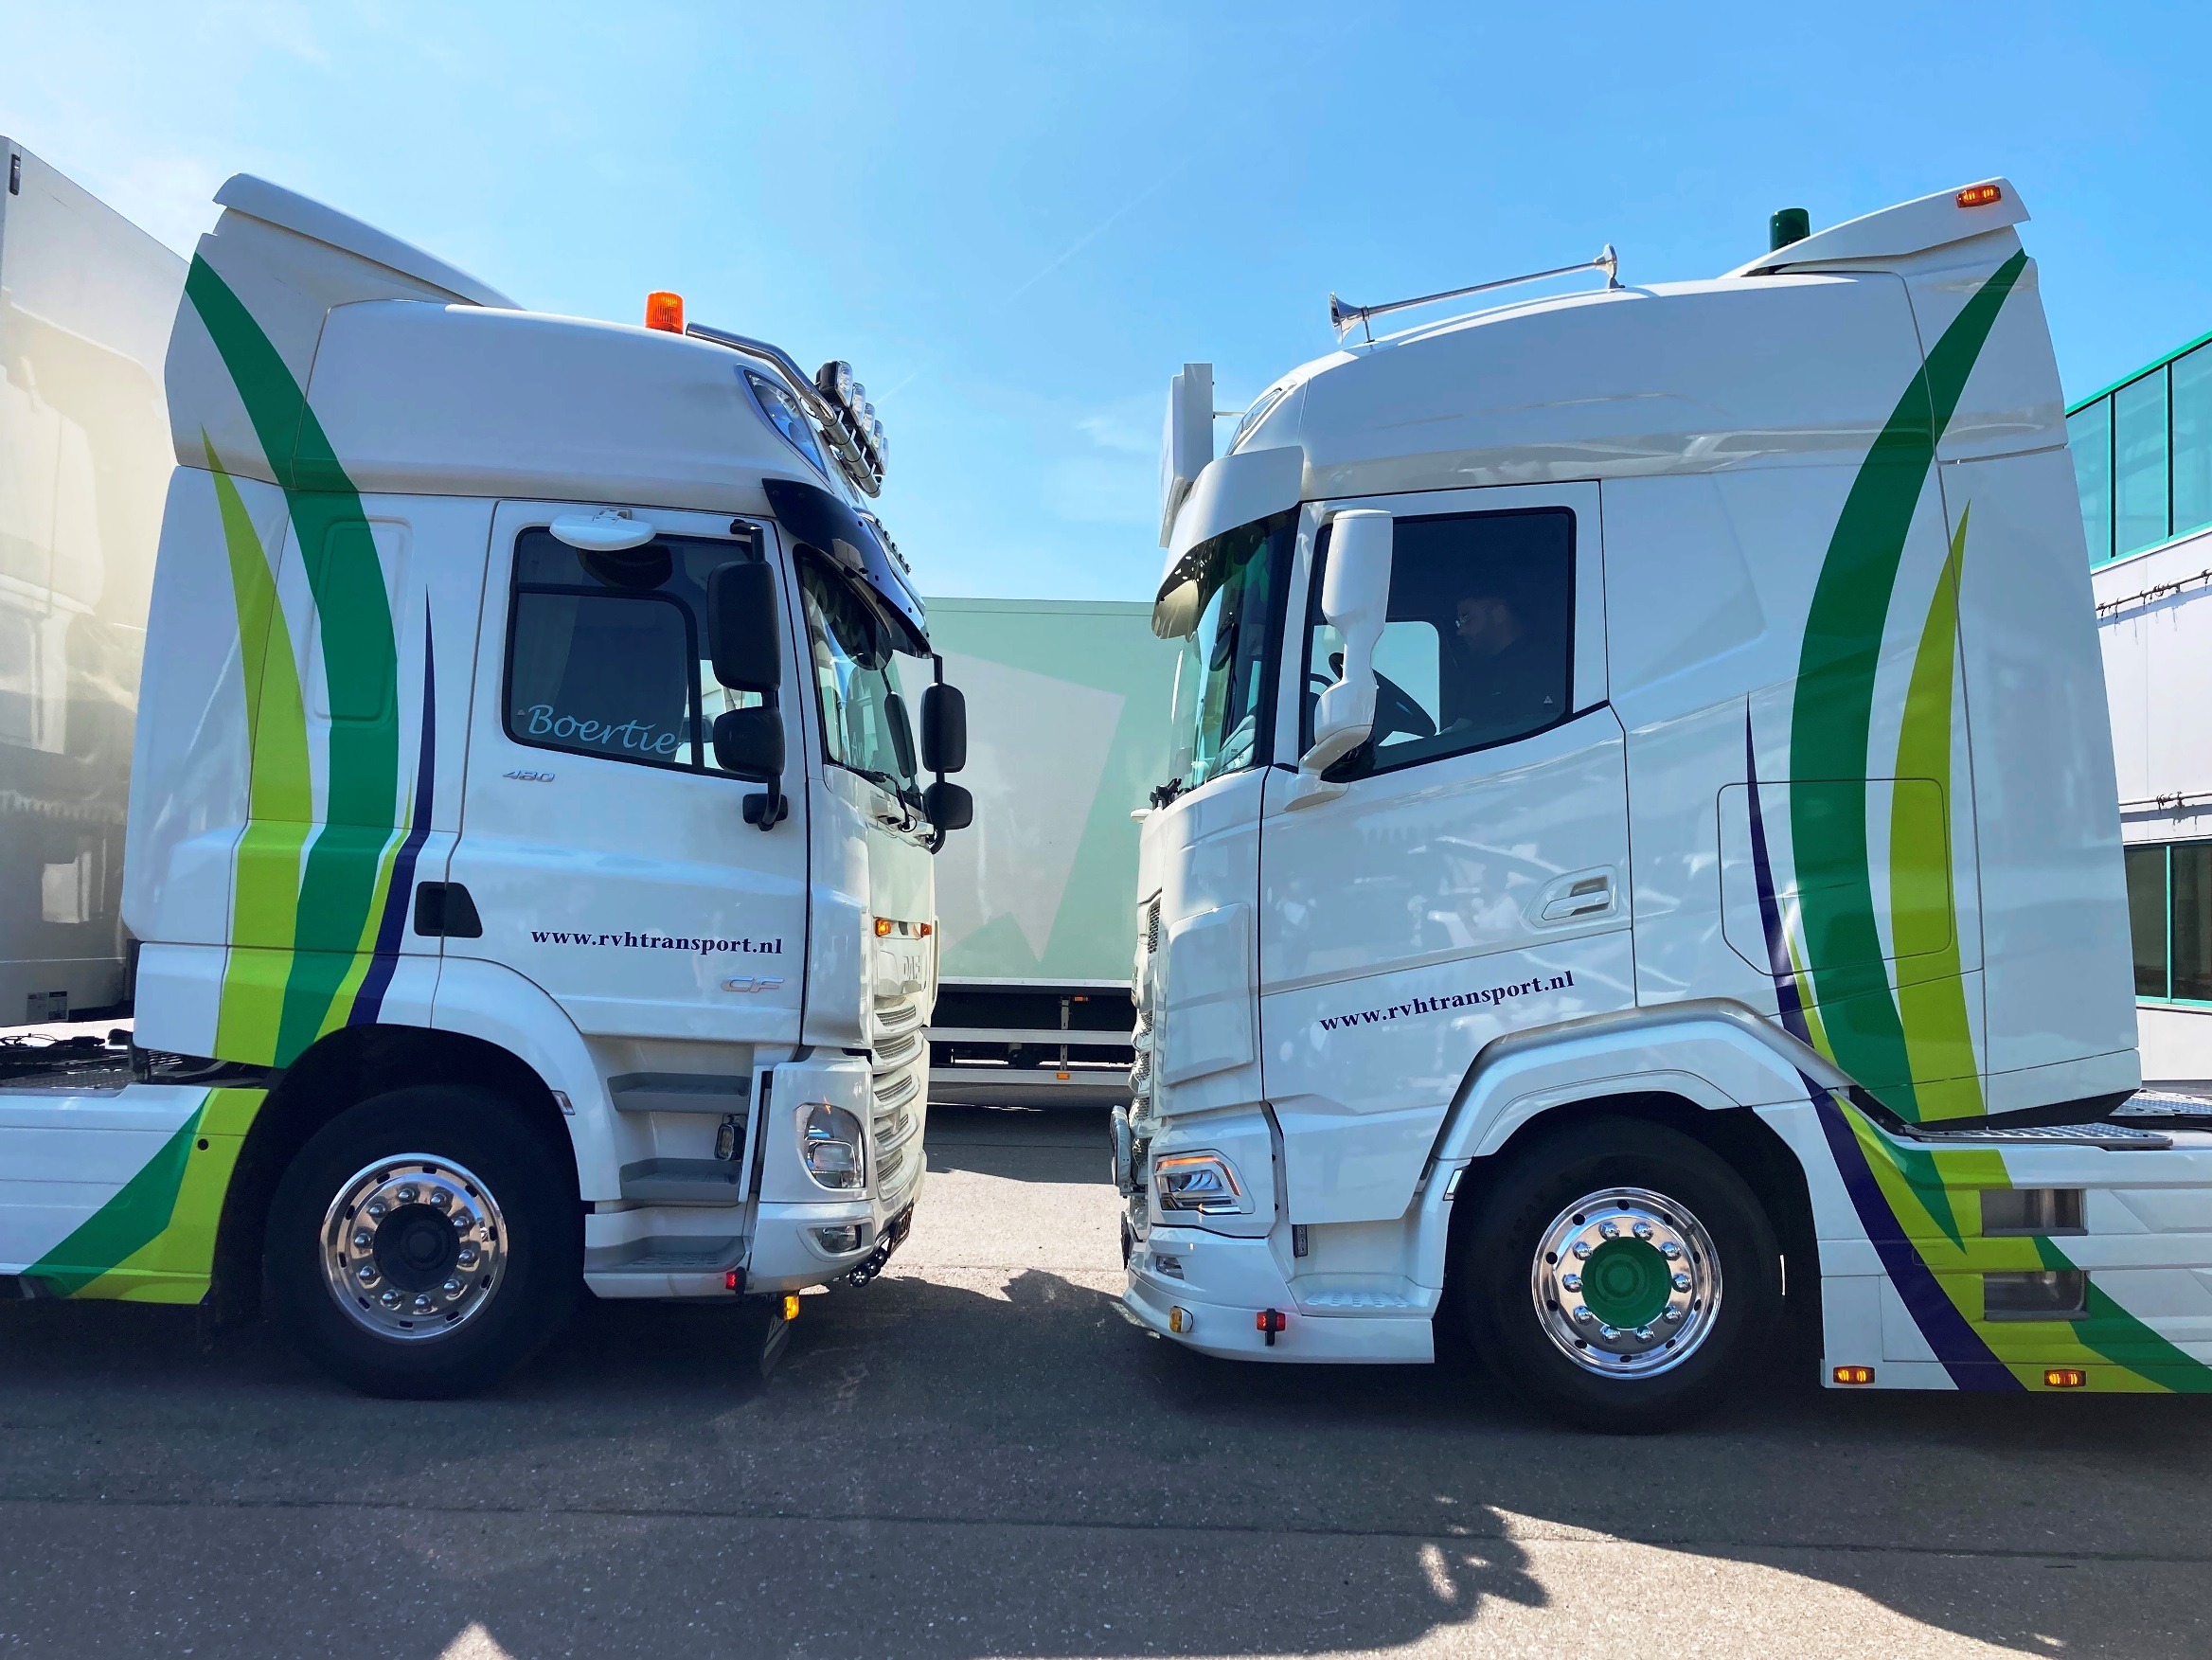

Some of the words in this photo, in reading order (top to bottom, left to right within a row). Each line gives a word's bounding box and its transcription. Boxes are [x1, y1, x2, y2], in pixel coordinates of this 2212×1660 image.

[527, 704, 685, 754] Boertie
[530, 930, 783, 955] www.rvhtransport.nl
[721, 975, 785, 992] CF
[1319, 970, 1575, 1031] www.rvhtransport.nl
